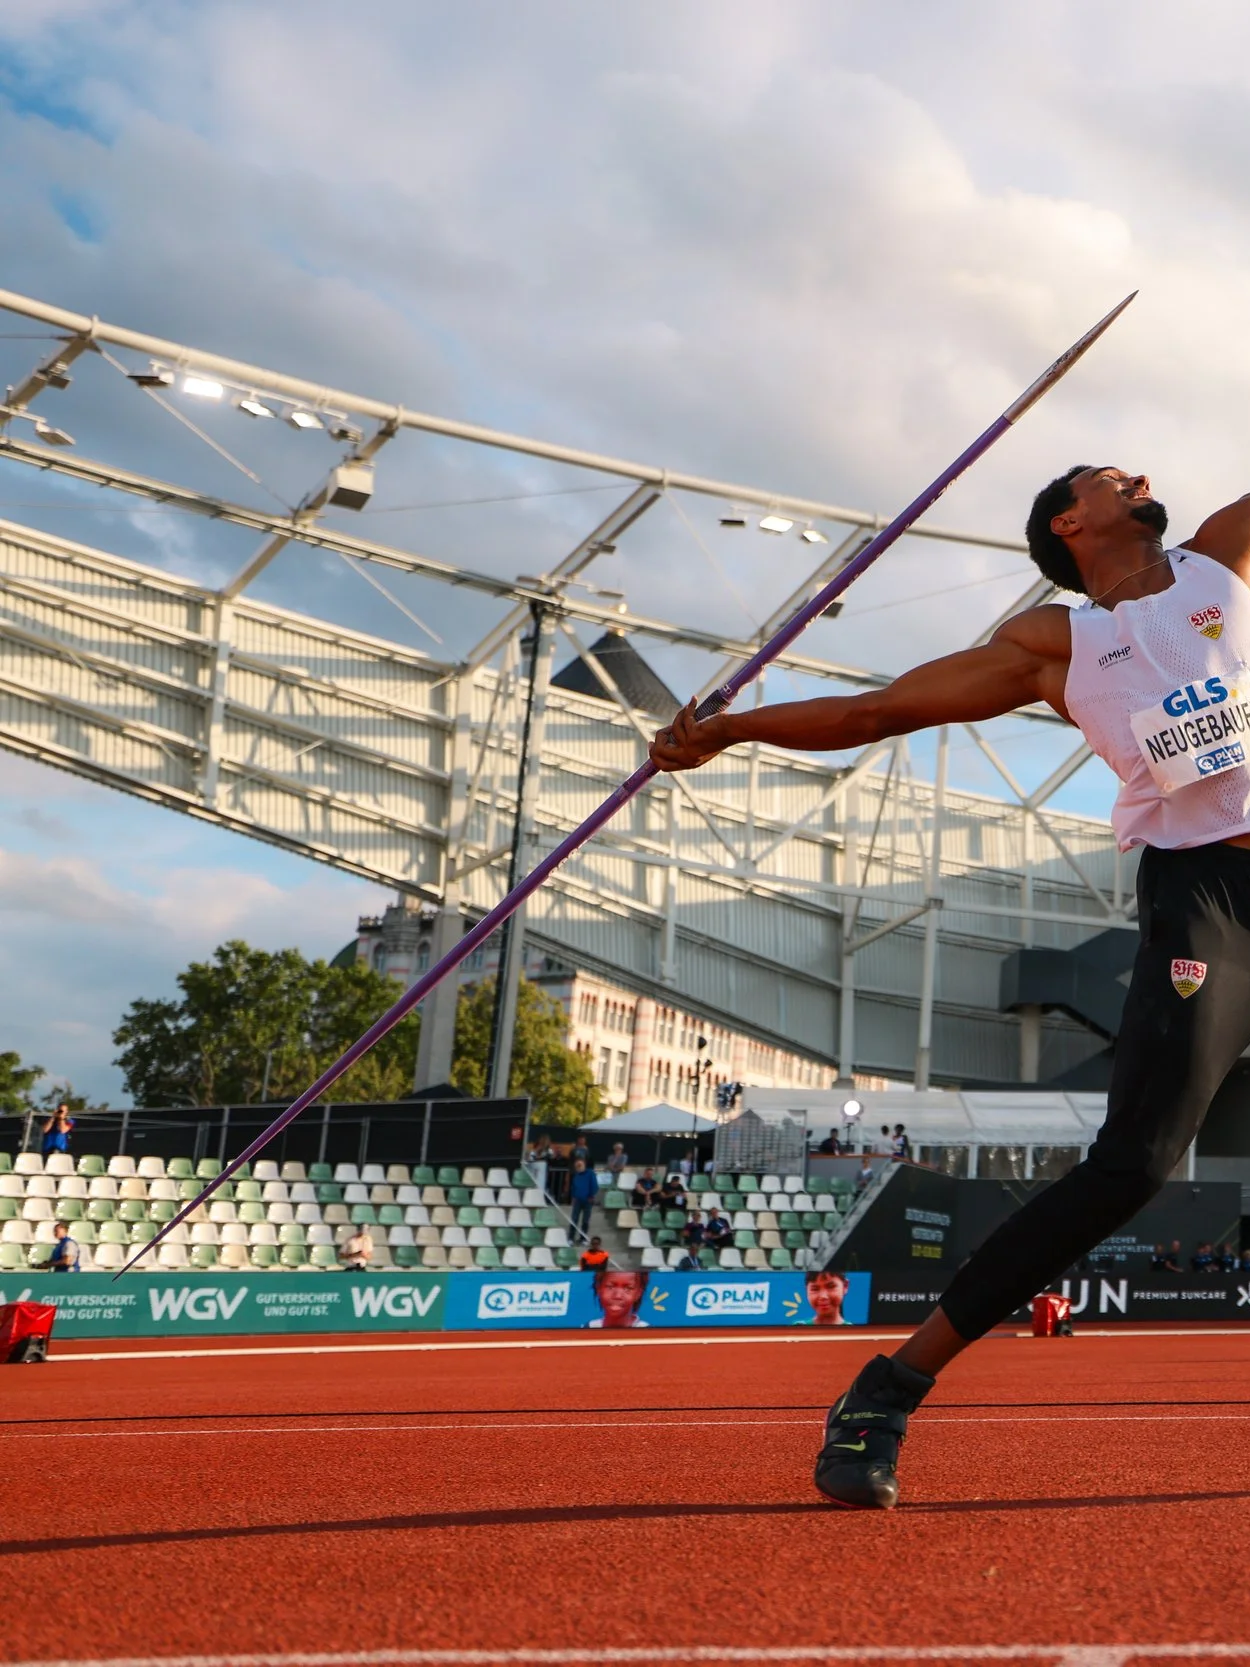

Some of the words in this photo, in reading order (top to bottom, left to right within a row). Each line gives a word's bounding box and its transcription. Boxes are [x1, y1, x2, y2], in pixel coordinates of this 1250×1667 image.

[1107, 645, 1131, 661] MHP
[67, 1294, 137, 1306] VERSICHERT.
[256, 1293, 279, 1304] GUT
[279, 1292, 341, 1304] VERSICHERT.
[351, 1285, 441, 1317] WGV
[518, 1290, 565, 1304] PLAN
[722, 1289, 765, 1303] PLAN
[877, 1292, 926, 1302] PREMIUM
[1133, 1291, 1178, 1300] PREMIUM
[1180, 1291, 1227, 1300] SUNCARE
[149, 1286, 248, 1321] WGV
[77, 1309, 102, 1320] GUT
[103, 1308, 123, 1319] IST.
[264, 1306, 287, 1317] UND
[288, 1306, 311, 1317] GUT
[312, 1305, 329, 1316] IST.
